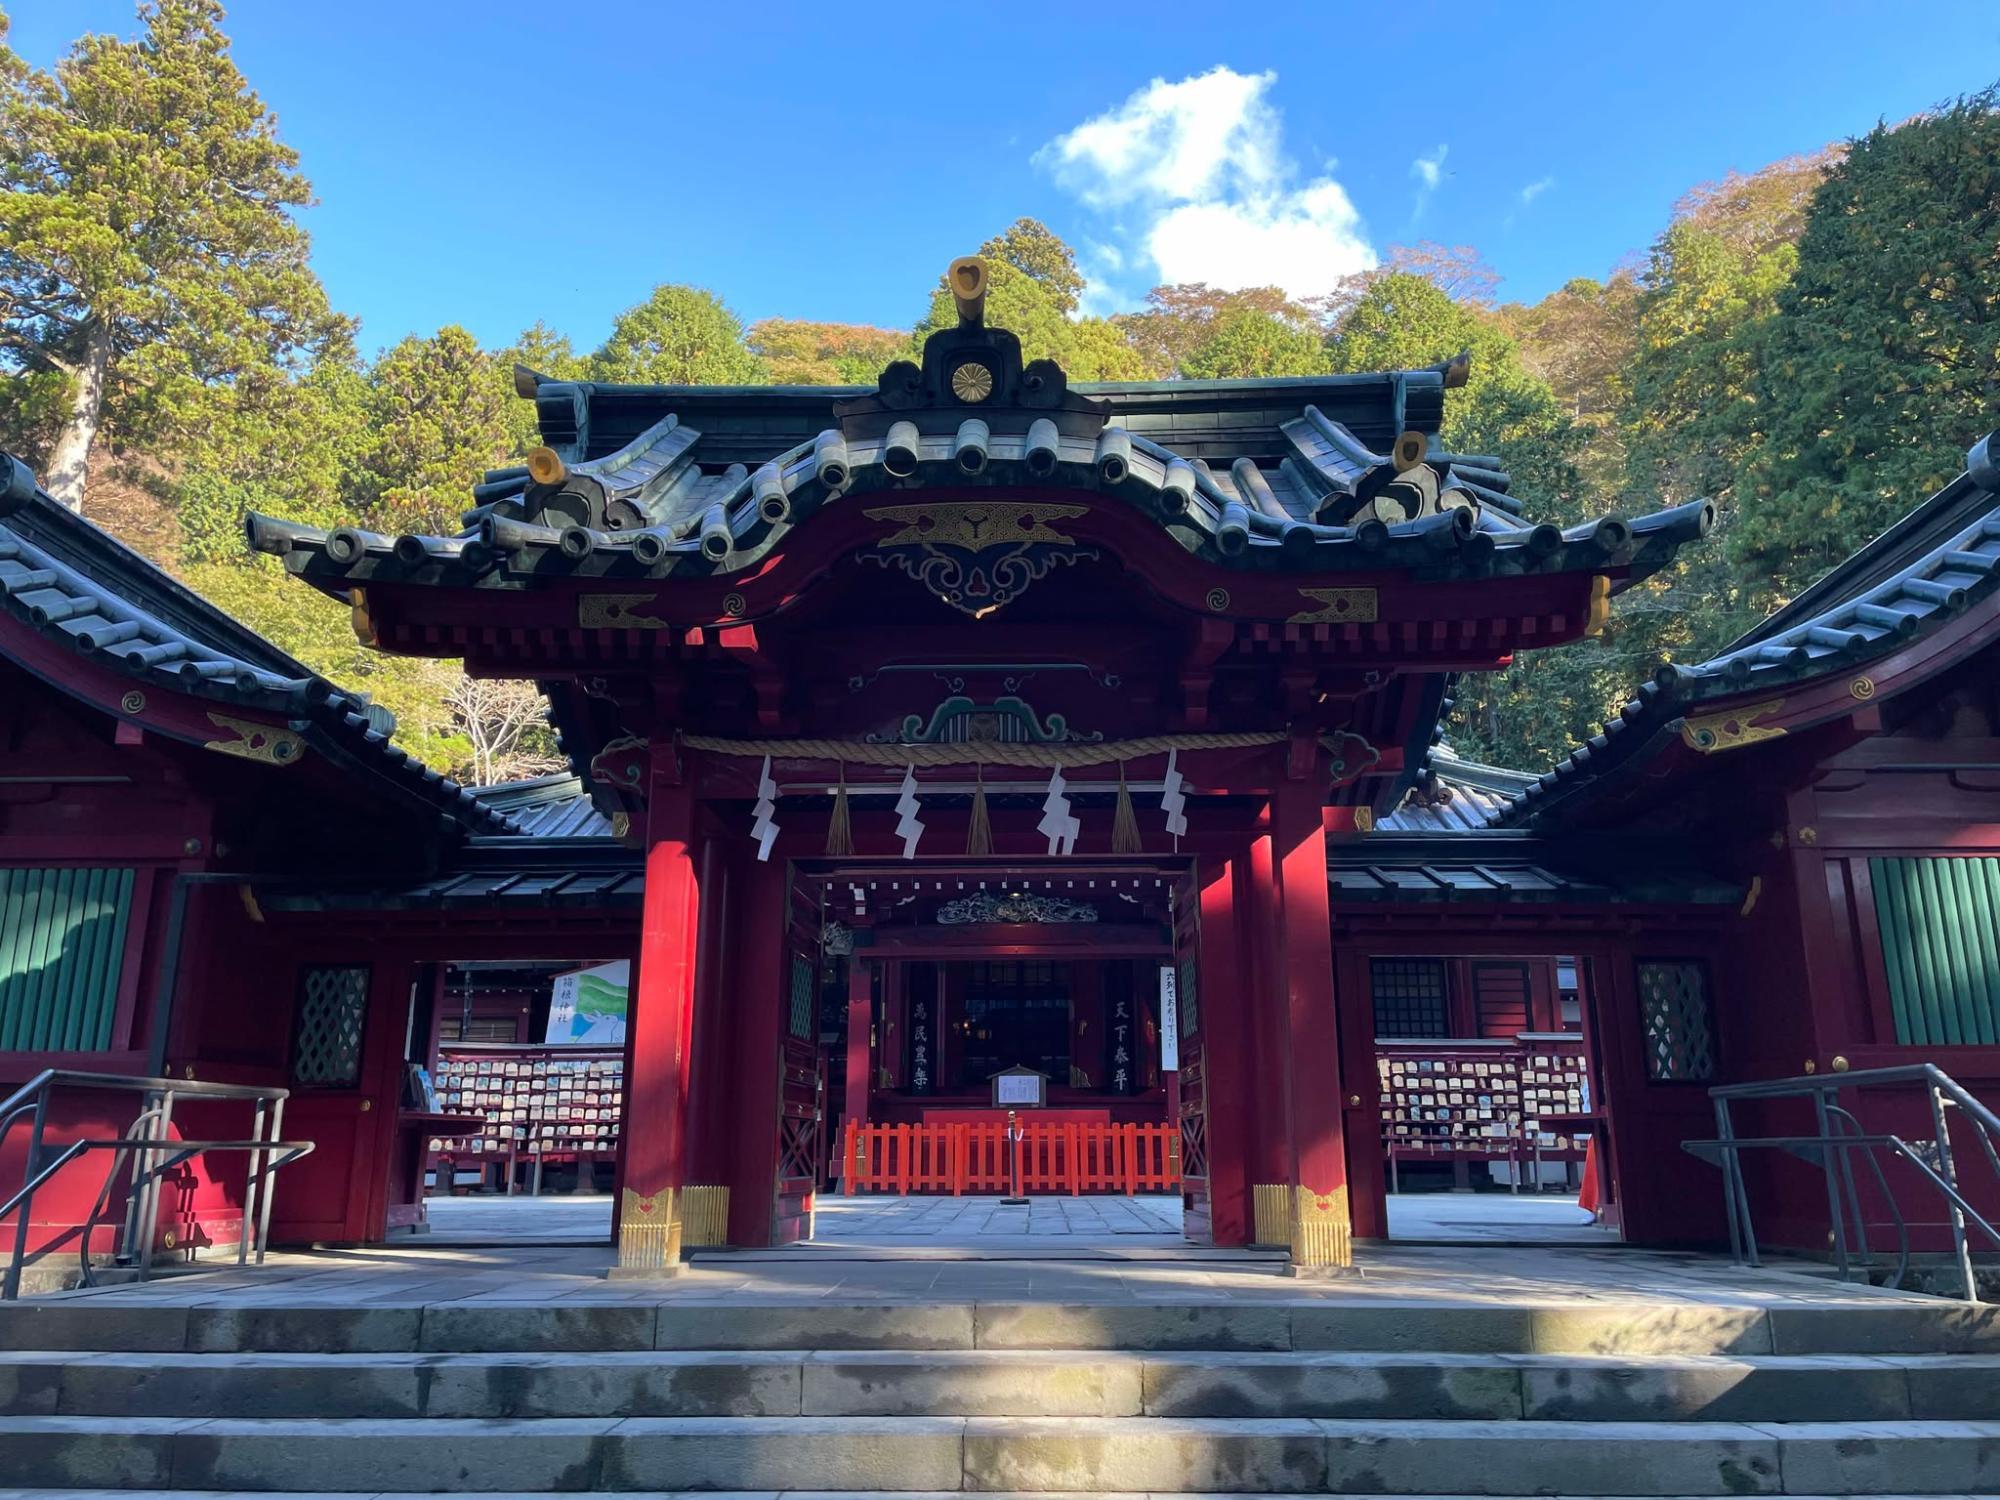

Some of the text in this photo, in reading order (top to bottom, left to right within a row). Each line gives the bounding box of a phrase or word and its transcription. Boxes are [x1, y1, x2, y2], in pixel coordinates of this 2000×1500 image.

[558, 977, 573, 1023] 箱根神社
[1114, 1001, 1129, 1091] 天下泰平
